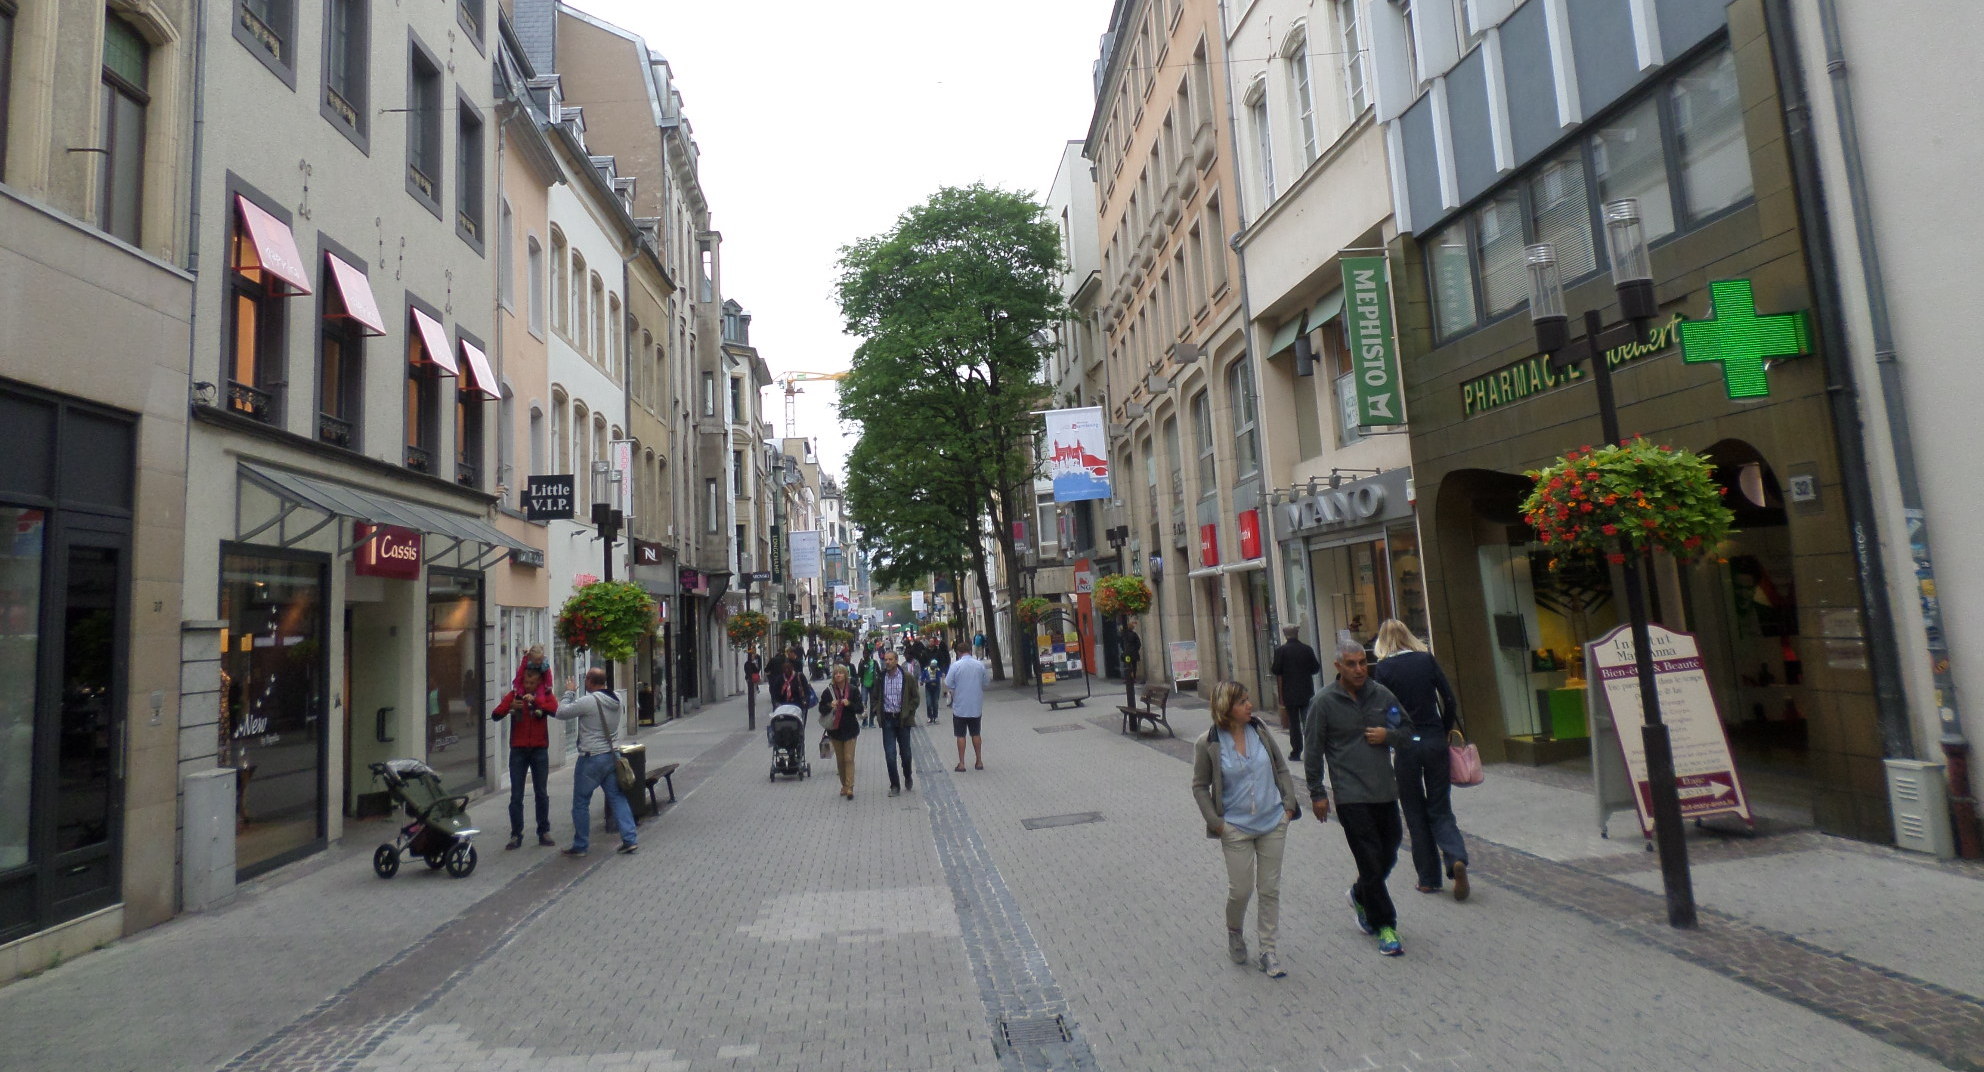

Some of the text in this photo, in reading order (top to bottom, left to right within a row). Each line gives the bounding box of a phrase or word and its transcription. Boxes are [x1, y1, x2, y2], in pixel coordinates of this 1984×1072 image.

[1353, 269, 1388, 387] MEPHISTO
[531, 484, 570, 497] Little
[1795, 480, 1809, 496] 32
[532, 499, 569, 511] V.I.P.
[1287, 484, 1384, 533] MANO
[381, 535, 417, 560] Cassis
[772, 535, 781, 573] LONGCHAMP
[1602, 665, 1639, 679] Bien-êt
[1664, 659, 1699, 671] Beauté
[243, 714, 267, 736] New
